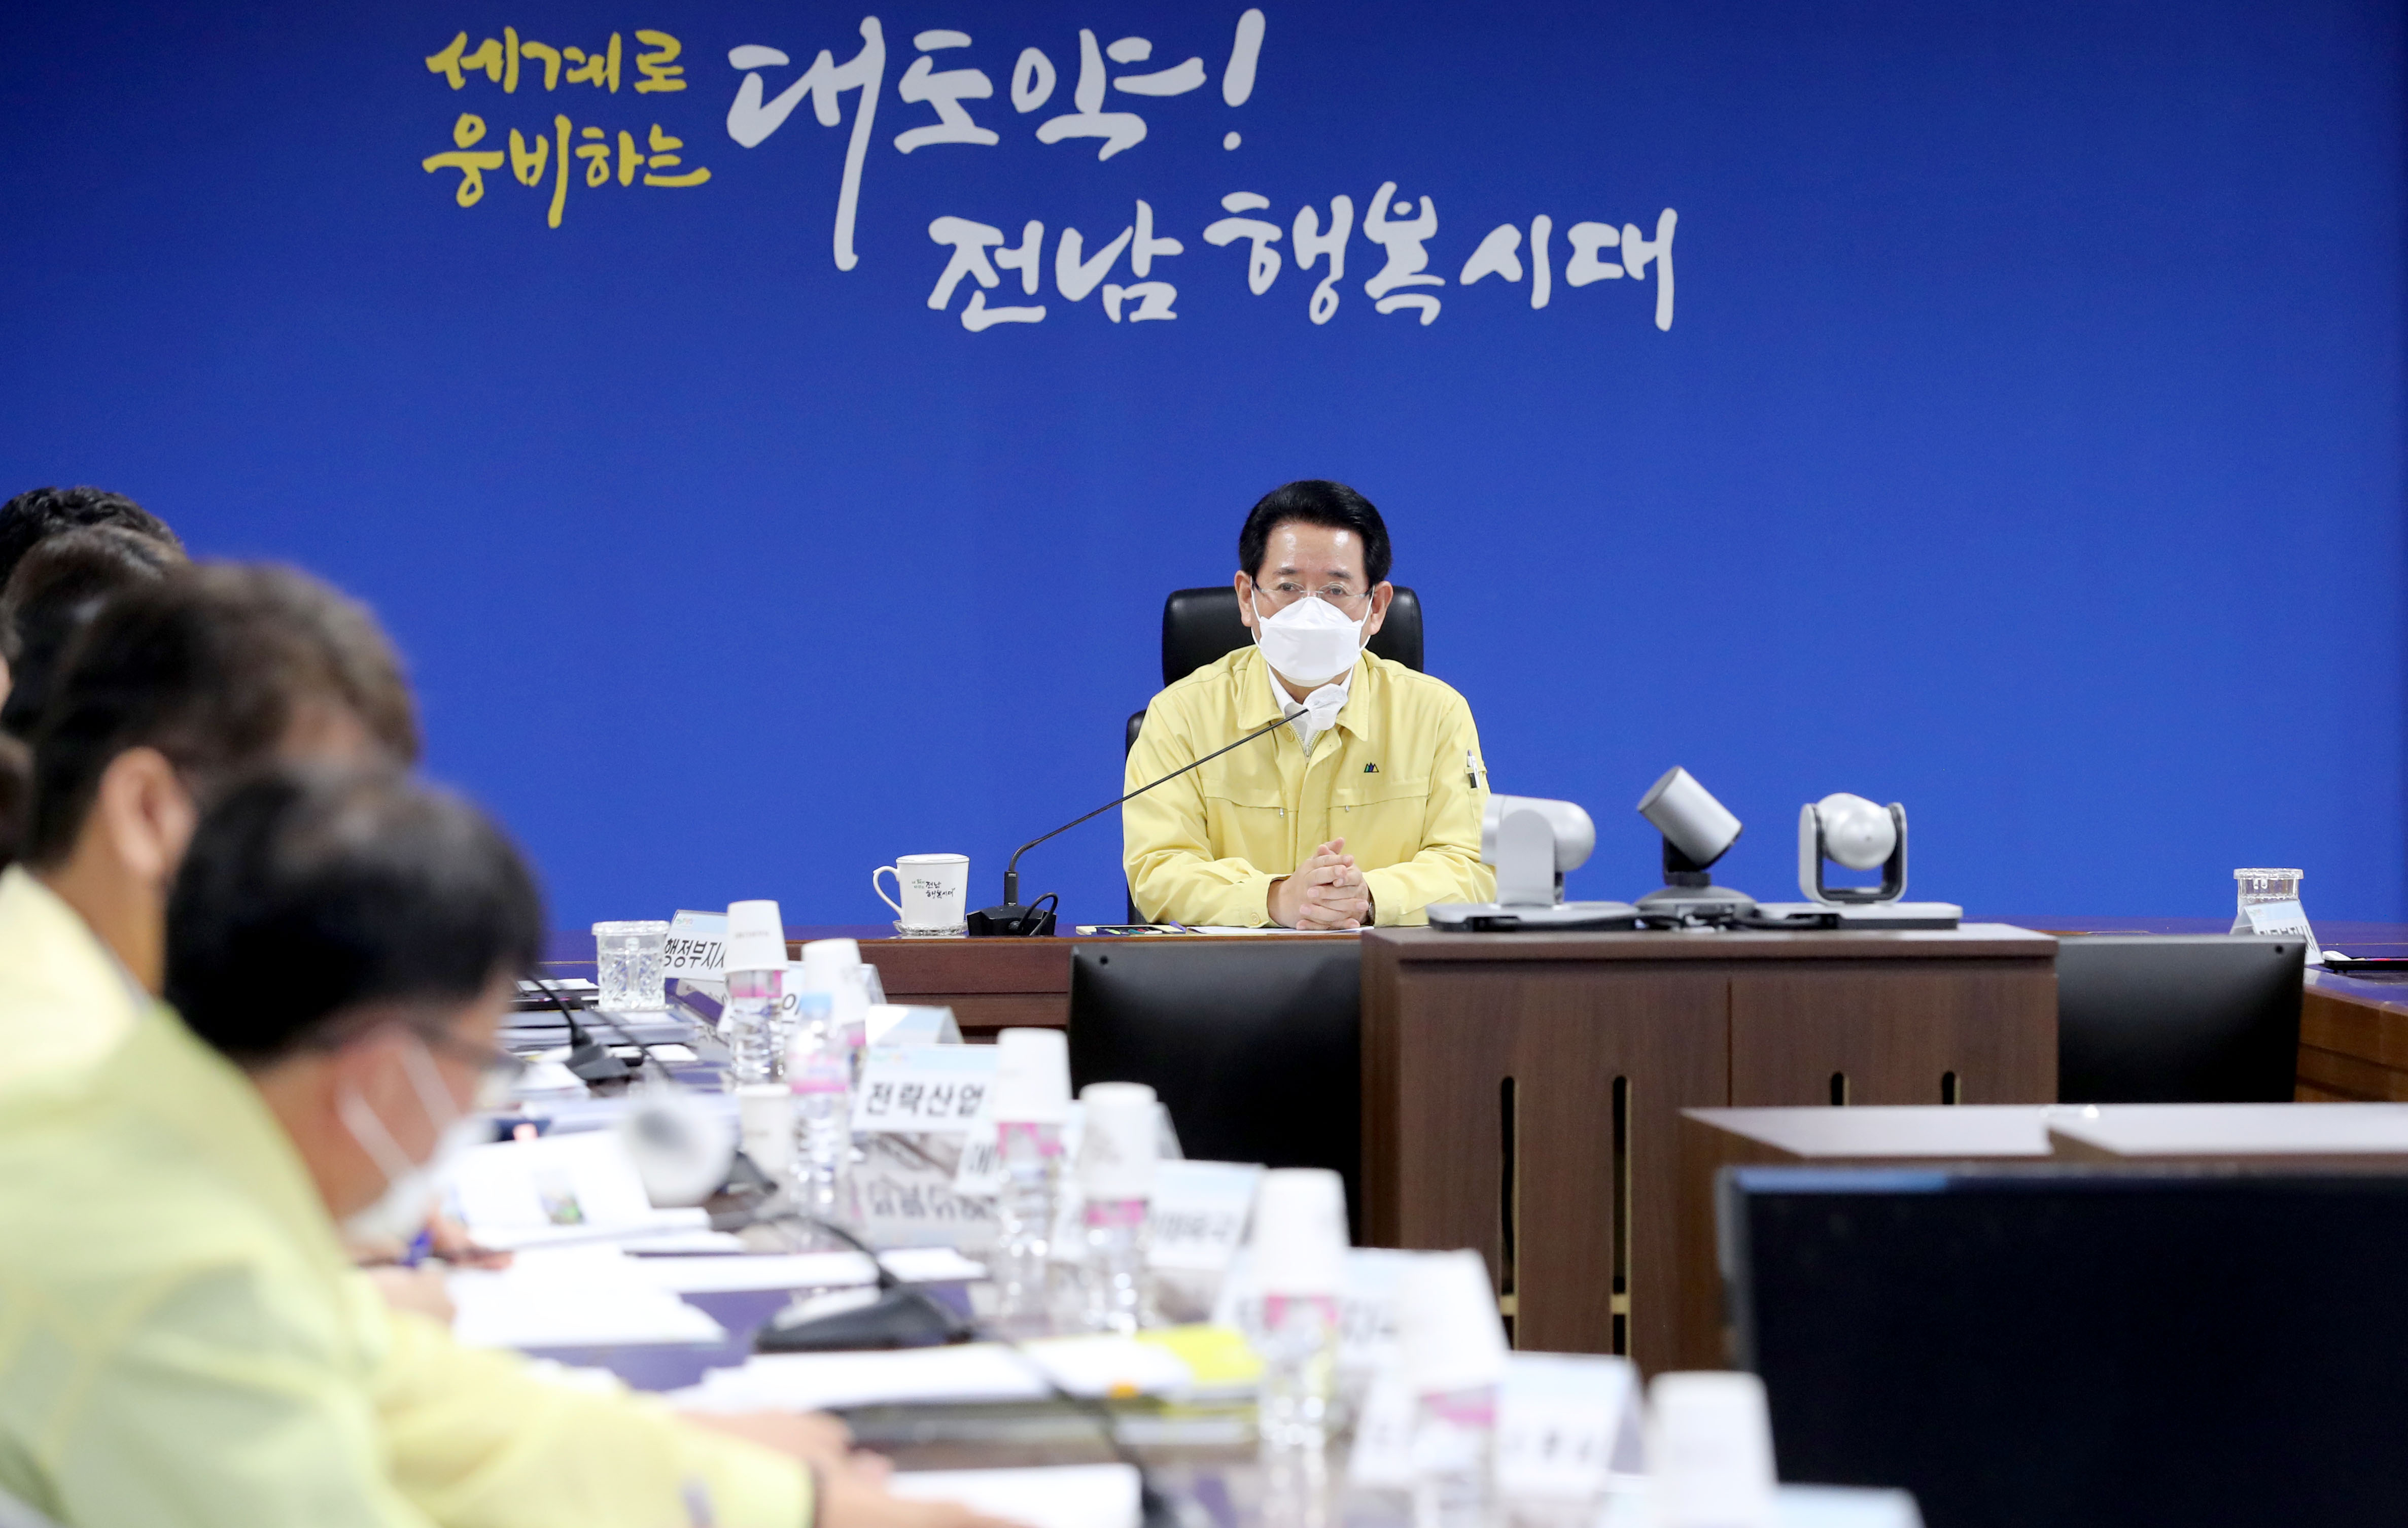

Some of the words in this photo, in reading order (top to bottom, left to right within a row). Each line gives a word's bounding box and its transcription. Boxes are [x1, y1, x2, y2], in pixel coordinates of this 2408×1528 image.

[426, 27, 687, 93] 세계로
[423, 114, 711, 228] 웅비하는
[727, 9, 1265, 271] 대도약!
[928, 200, 1183, 332] 전남
[866, 1082, 985, 1117] 전략산업
